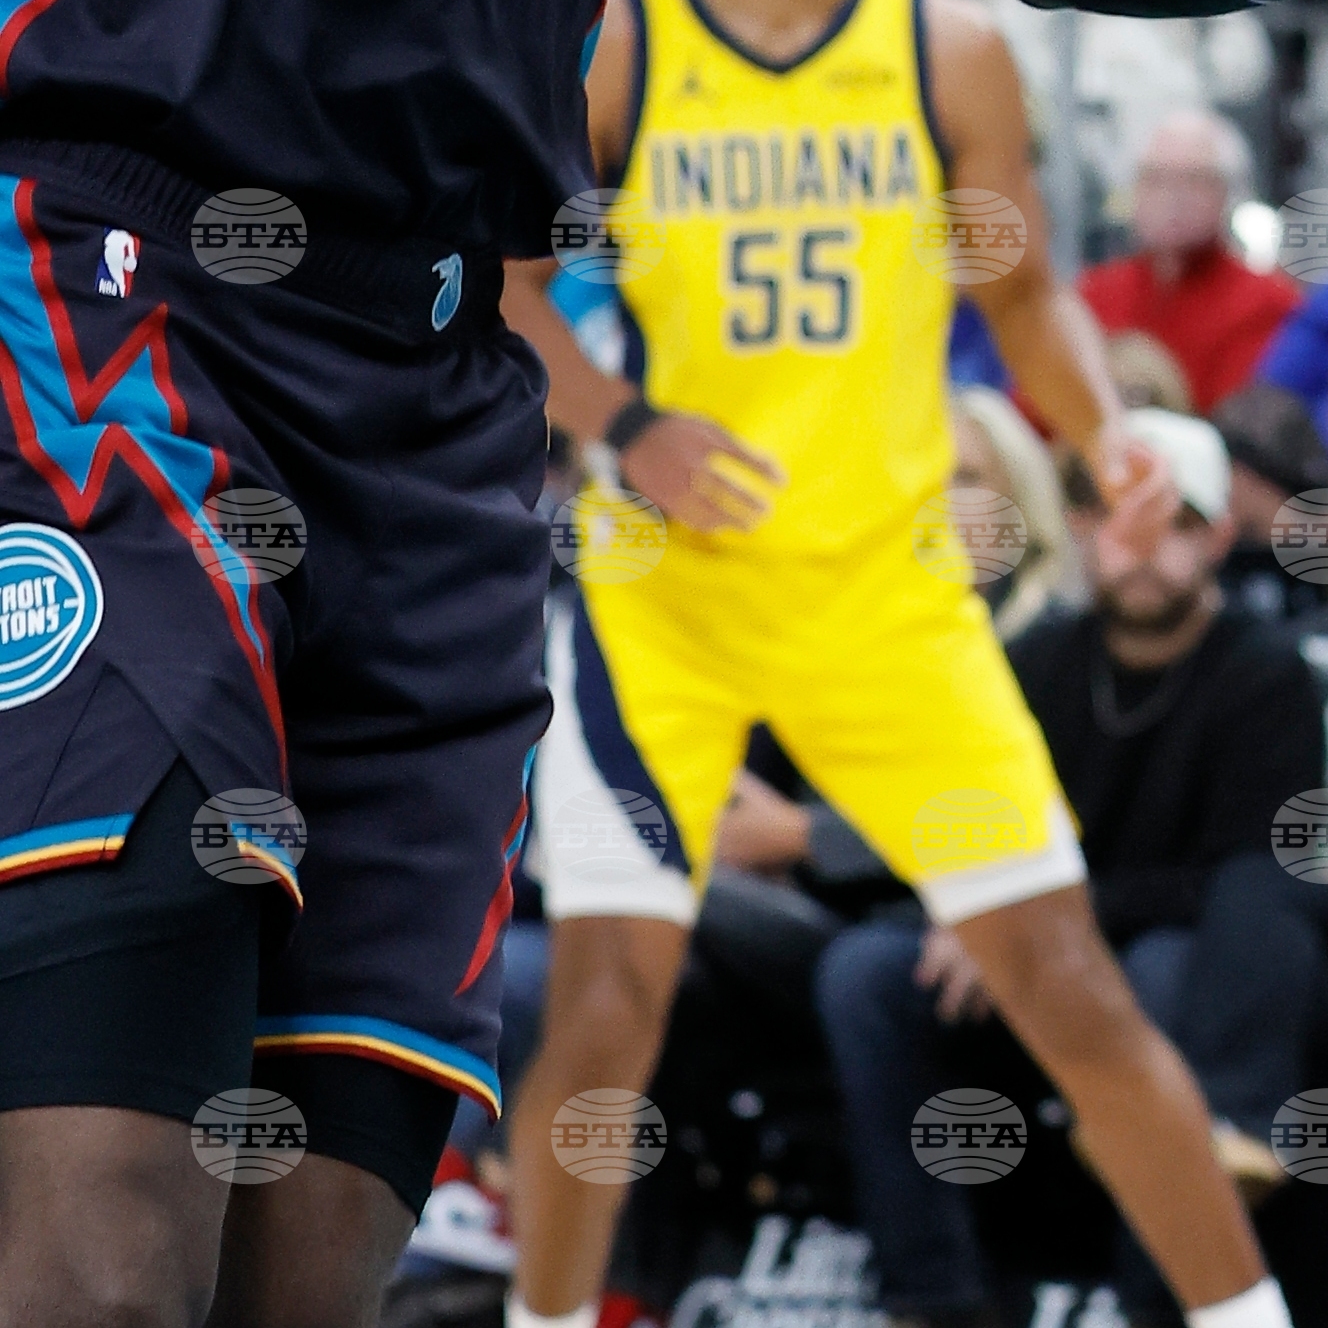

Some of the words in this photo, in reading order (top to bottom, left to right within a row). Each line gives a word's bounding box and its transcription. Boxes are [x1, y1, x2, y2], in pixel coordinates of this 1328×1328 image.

[648, 124, 922, 221] INDIANA
[724, 225, 859, 354] 55
[0, 574, 58, 615] ROIT
